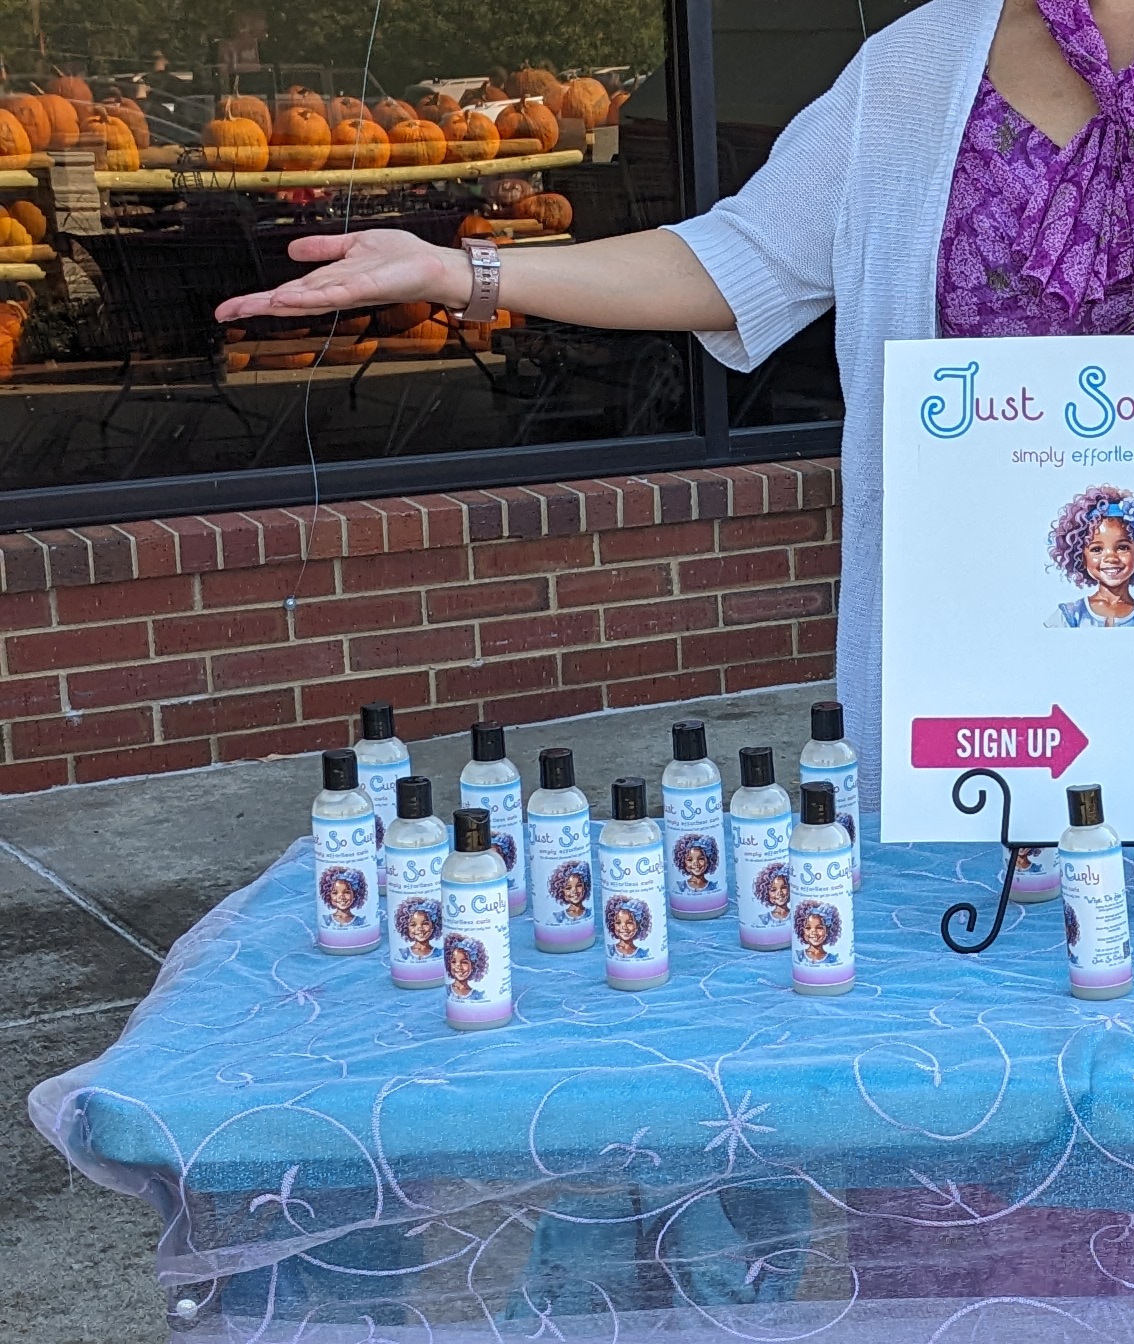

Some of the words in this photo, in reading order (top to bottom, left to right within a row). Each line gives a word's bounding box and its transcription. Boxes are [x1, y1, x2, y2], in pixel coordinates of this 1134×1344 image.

[920, 360, 1044, 439] Just
[1011, 446, 1064, 468] simply
[956, 727, 1017, 759] SIGN
[1027, 727, 1061, 758] UP
[680, 799, 702, 821] So
[325, 830, 347, 853] So
[558, 825, 580, 847] So
[763, 827, 784, 850] So
[403, 860, 426, 883] So
[609, 858, 631, 881] So
[800, 862, 822, 886] So
[1064, 862, 1100, 886] Curly
[446, 894, 466, 917] So
